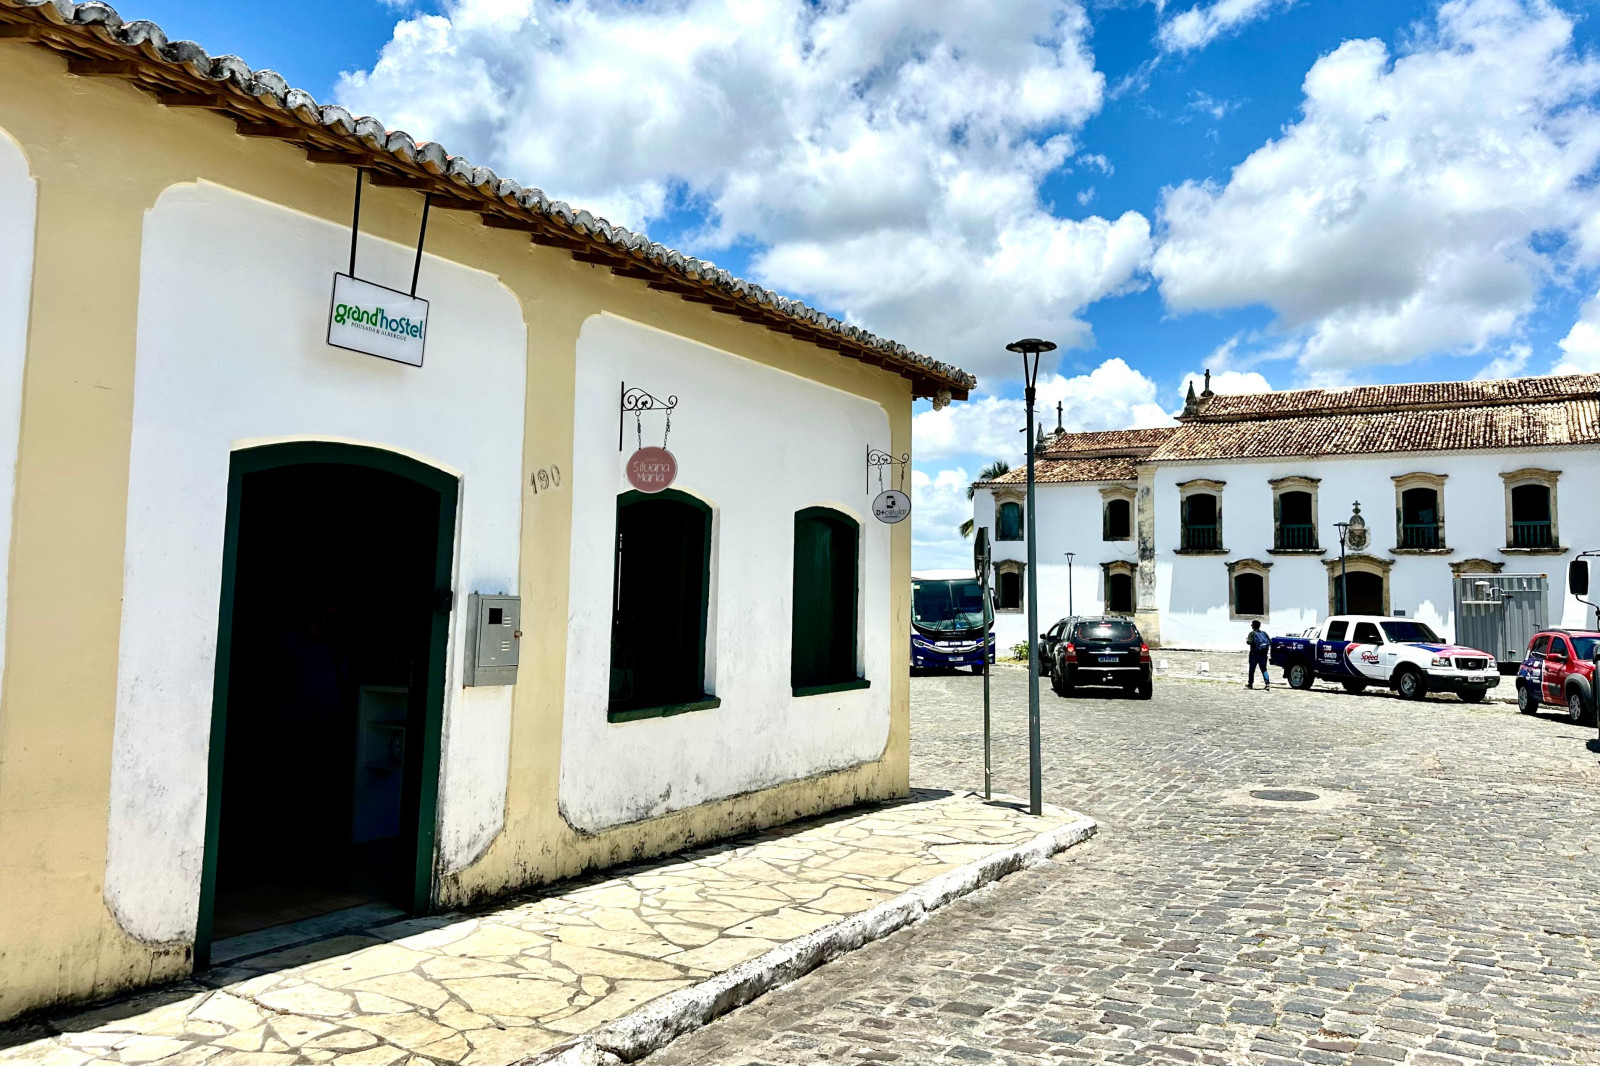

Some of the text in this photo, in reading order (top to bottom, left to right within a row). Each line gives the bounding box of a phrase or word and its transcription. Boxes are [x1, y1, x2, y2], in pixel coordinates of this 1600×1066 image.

[351, 322, 375, 333] POUSADA
[530, 464, 560, 494] 190
[637, 472, 665, 483] Maria
[1360, 651, 1379, 663] Speed
